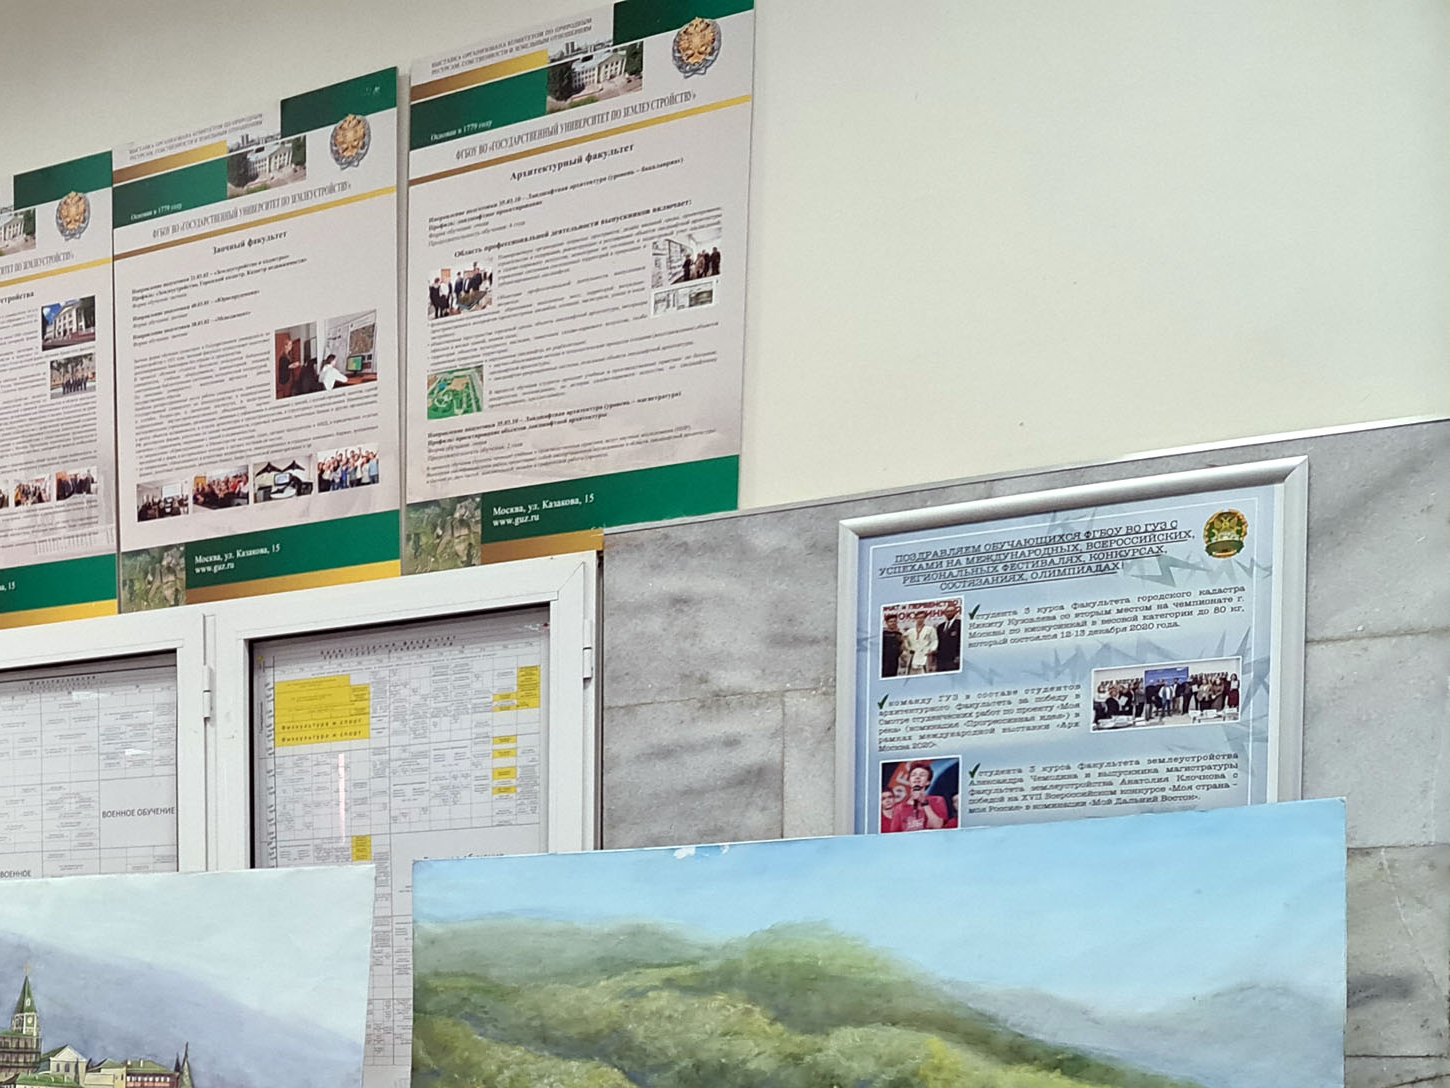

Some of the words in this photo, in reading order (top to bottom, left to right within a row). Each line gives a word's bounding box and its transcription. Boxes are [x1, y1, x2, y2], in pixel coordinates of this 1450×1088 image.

[510, 154, 583, 180] Архитектурный
[584, 144, 634, 164] факультет
[213, 239, 246, 254] Заочный
[247, 232, 287, 248] факультет
[492, 506, 526, 515] Москва,
[528, 504, 540, 514] ул.
[542, 499, 582, 509] Казакова,
[584, 494, 594, 504] 15
[492, 514, 540, 526] www.guz.ru
[894, 545, 980, 563] ПОЗДРАВЛЯЕМ
[983, 532, 1080, 551] ОБУЧАЮЩИХСЯ
[1083, 526, 1123, 539] ФГБОУ
[1125, 524, 1140, 533] ВО
[1144, 521, 1166, 531] ГУЗ
[1169, 520, 1178, 528] С
[194, 554, 222, 563] Москва,
[224, 553, 234, 561] ул.
[236, 547, 270, 557] Казакова,
[271, 542, 280, 552] 15
[878, 560, 942, 575] УСПЕХАМИ
[945, 558, 962, 567] НА
[965, 544, 1082, 565] МЕЖДУНАРОДНЫХ,
[1085, 530, 1195, 550] ВСЕРОССИЙСКИХ,
[194, 562, 235, 573] www.guz.ru
[902, 565, 998, 584] РЕГИОНАЛЬНЫХ
[1000, 555, 1085, 572] ФЕСТИВАЛЯХ,
[1088, 545, 1167, 561] КОНКУРСАХ,
[938, 574, 1028, 591] СОСТЯЗАНИЯХ,
[1136, 591, 1192, 602] городского
[1198, 585, 1245, 595] кадастра
[1115, 604, 1152, 614] местом
[1172, 596, 1233, 608] чемпионате
[1142, 610, 1193, 620] категории
[1196, 608, 1209, 616] до
[1212, 605, 1226, 613] 80
[1128, 622, 1154, 631] 2020
[1146, 752, 1238, 764] землеустройства
[1165, 762, 1238, 773] магистратуры
[1194, 782, 1230, 791] страна
[102, 808, 136, 818] ВОЕННОЕ
[137, 806, 175, 817] ОБУЧЕНИЕ
